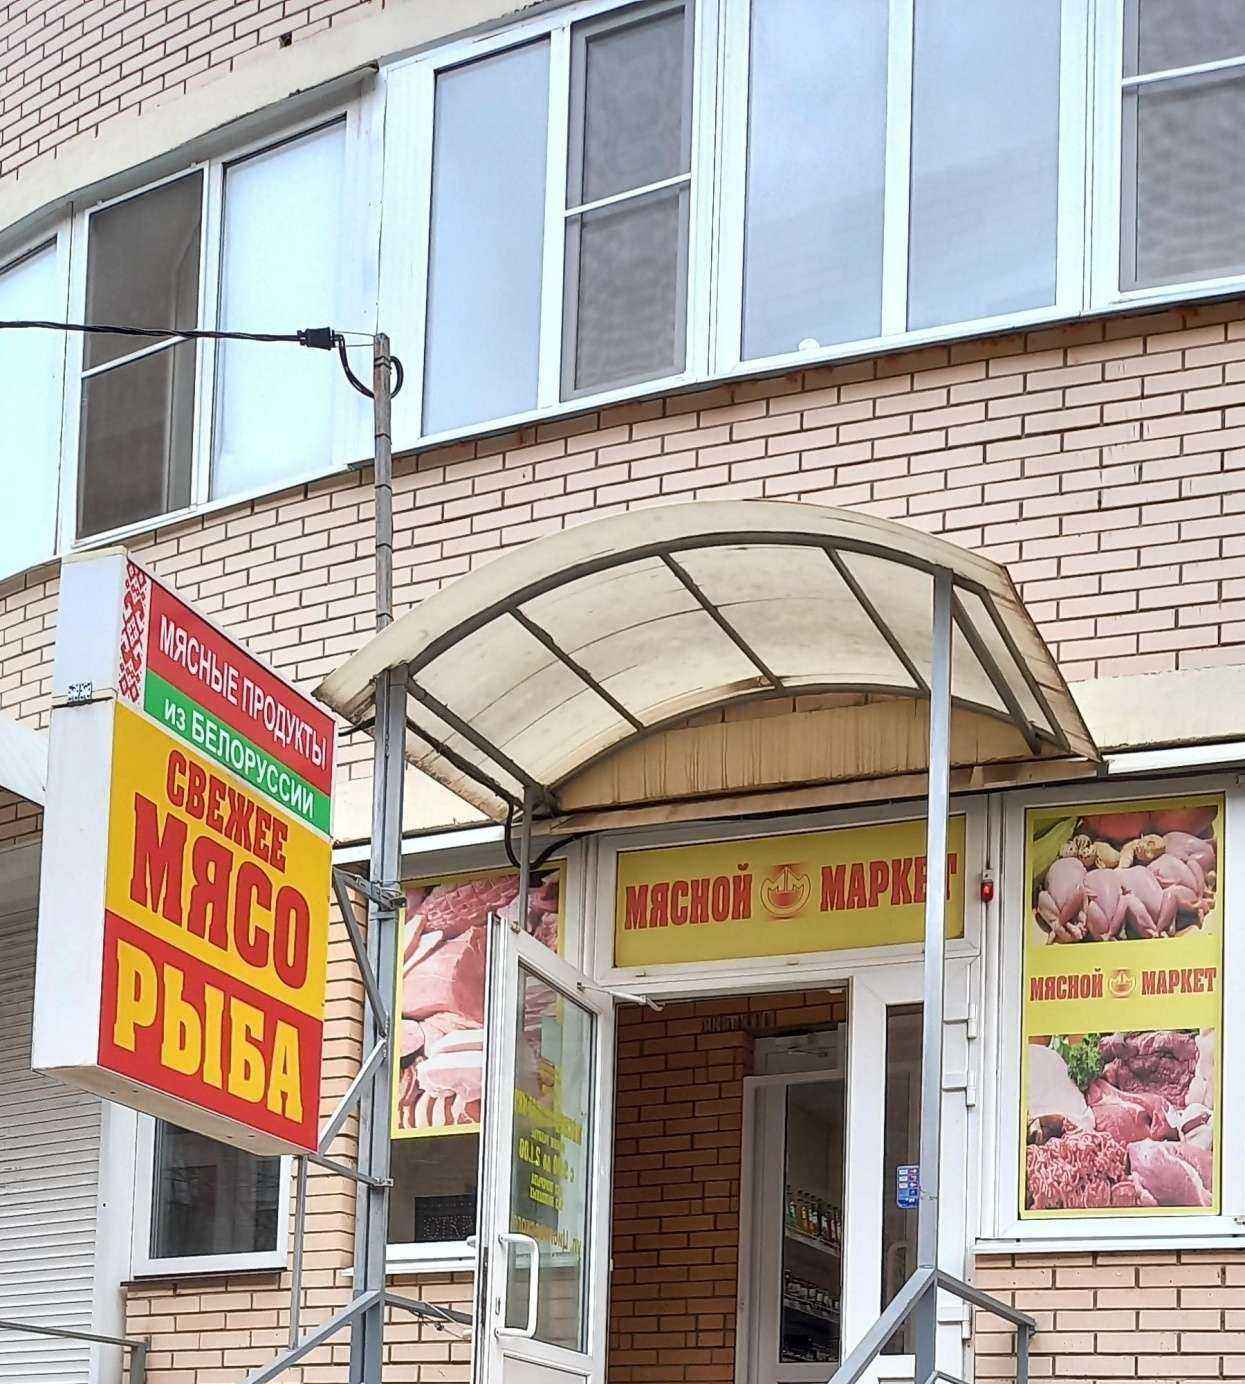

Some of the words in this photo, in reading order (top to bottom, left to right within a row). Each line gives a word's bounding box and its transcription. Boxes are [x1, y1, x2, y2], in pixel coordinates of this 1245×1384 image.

[160, 614, 239, 706] МЯСНЫЕ
[241, 676, 327, 771] ПРОДУКТЫ
[166, 749, 289, 875] СВЕЖЕЕ
[191, 710, 315, 819] БЕЛОРУССИИ
[129, 792, 311, 990] МЯСО
[624, 862, 753, 930] МЯСНОЙ
[113, 938, 305, 1125] РЫБА
[1030, 967, 1104, 1001] МЯСНОЙ
[1141, 967, 1218, 995] МАРКЕТ
